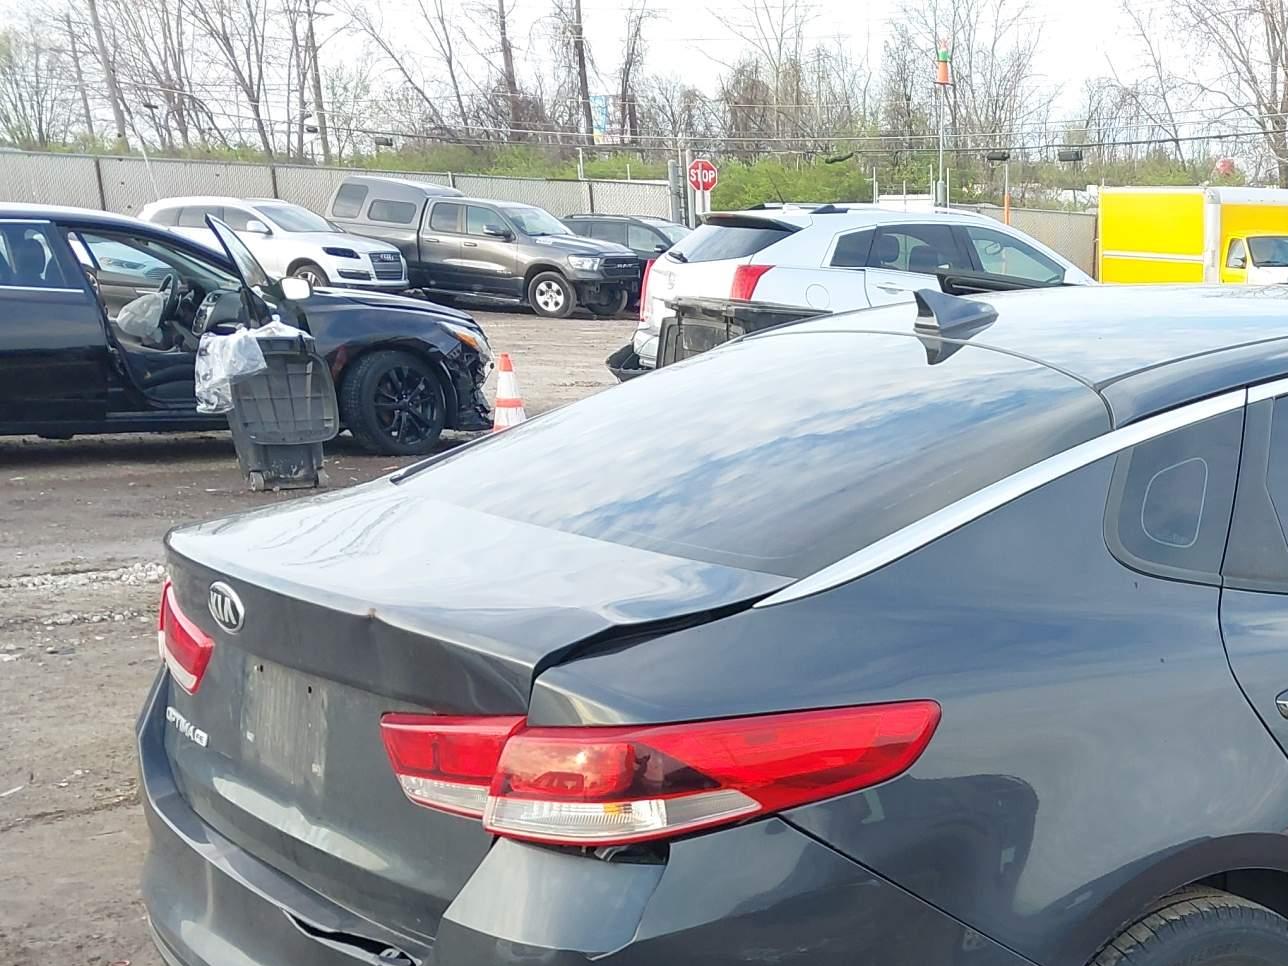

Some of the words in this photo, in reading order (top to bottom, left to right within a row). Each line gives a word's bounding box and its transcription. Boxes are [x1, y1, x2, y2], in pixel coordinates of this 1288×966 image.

[690, 168, 715, 182] STOP
[210, 590, 237, 625] KIA
[166, 706, 195, 741] OPTIMA
